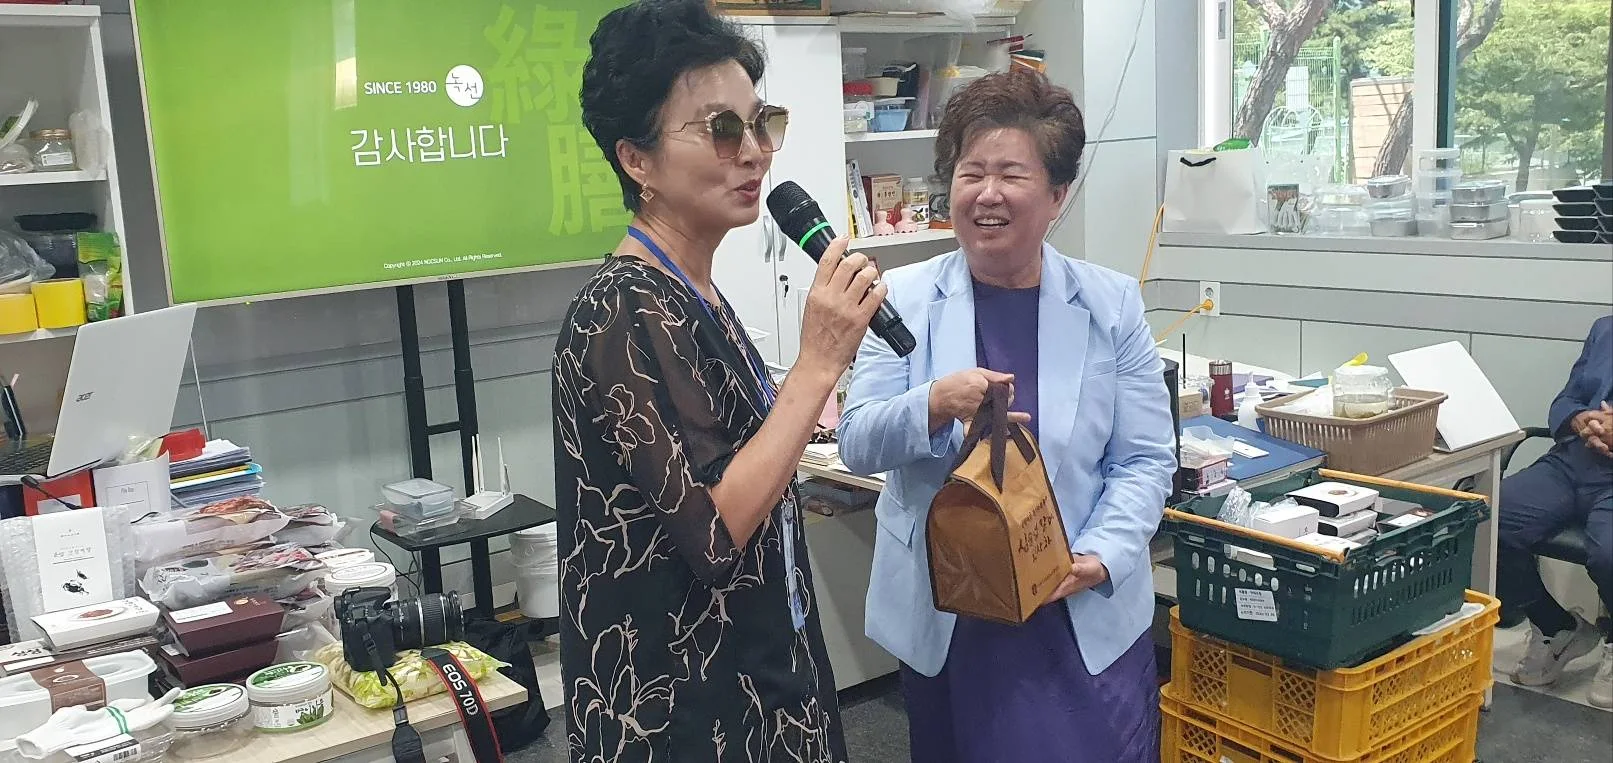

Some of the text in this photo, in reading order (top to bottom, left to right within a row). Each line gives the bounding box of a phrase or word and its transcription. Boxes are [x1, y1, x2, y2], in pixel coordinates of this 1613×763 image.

[364, 81, 437, 95] SINCE 1980
[446, 72, 481, 100] 녹선
[350, 124, 509, 166] 감사합니다
[383, 262, 405, 270] Copyright
[442, 663, 479, 716] EOS 70D
